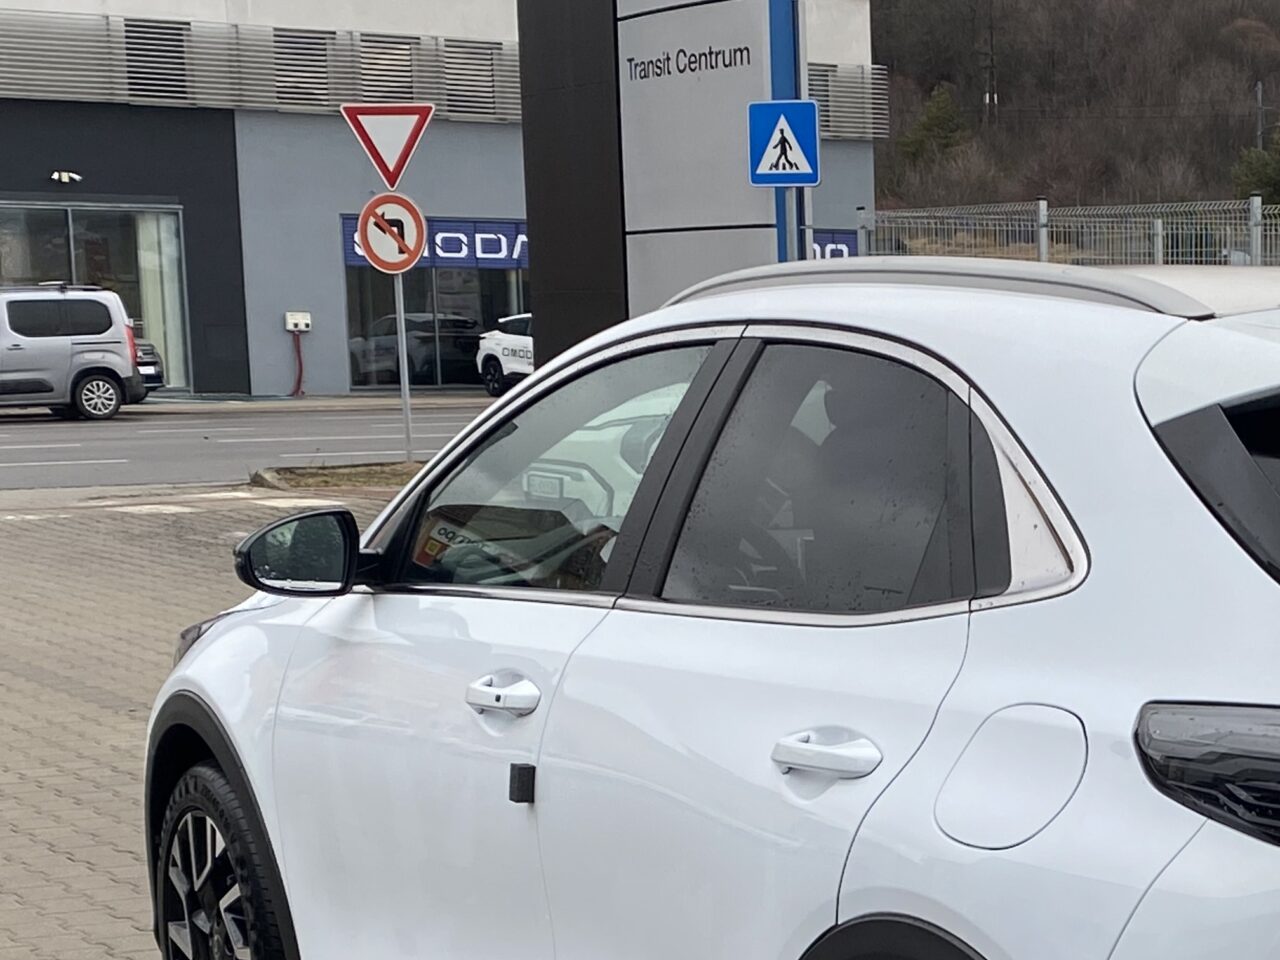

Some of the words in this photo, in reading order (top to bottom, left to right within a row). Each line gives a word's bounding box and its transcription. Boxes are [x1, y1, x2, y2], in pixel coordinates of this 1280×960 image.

[626, 51, 672, 81] Transit
[675, 45, 751, 74] Centrum
[502, 347, 533, 360] OMOD
